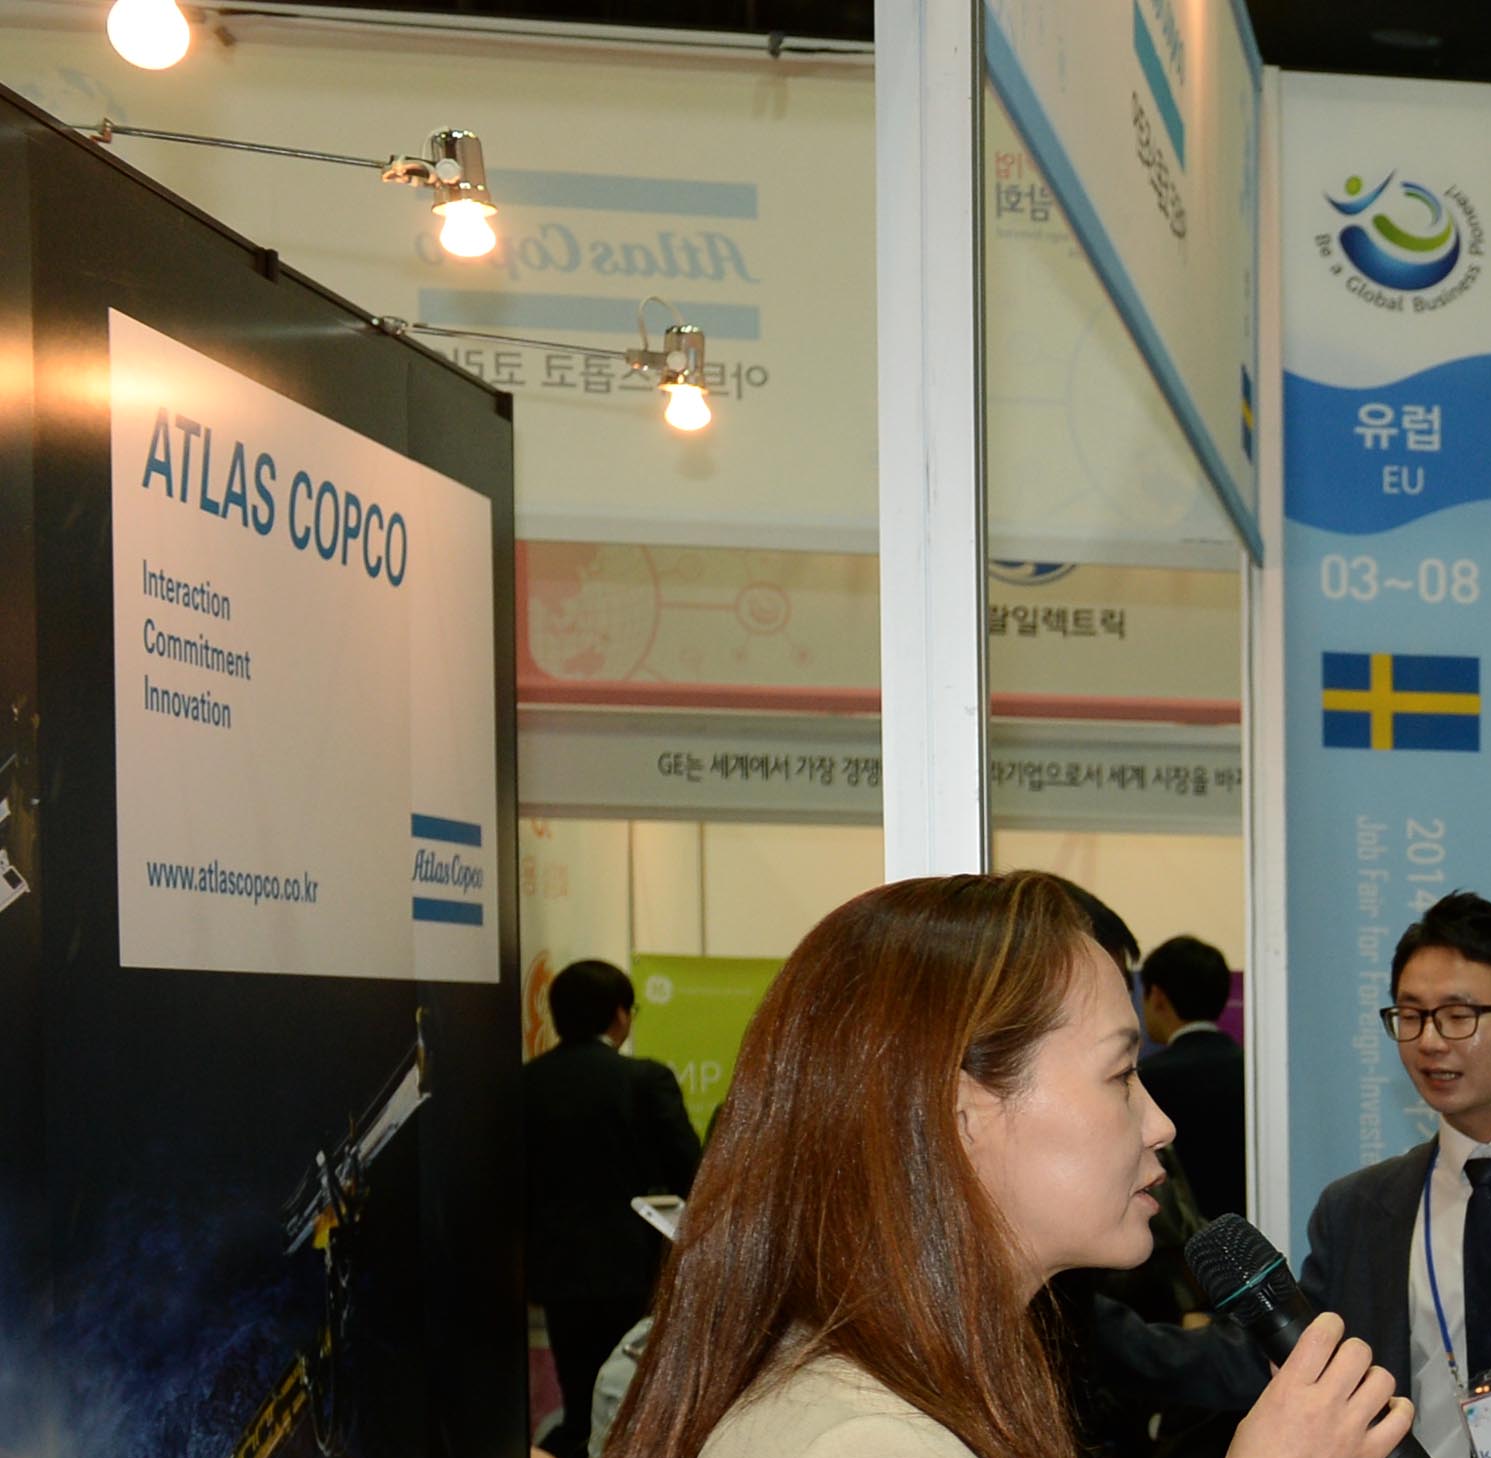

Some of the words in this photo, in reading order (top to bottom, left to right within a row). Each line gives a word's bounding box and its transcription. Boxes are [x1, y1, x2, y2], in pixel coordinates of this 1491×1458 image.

[1345, 275, 1404, 312] Global
[1412, 263, 1481, 313] Business
[1355, 402, 1441, 453] 유럽
[142, 406, 275, 536] ATLAS
[288, 470, 407, 586] COPCO
[1382, 465, 1425, 496] EU
[142, 559, 231, 621] Interaction
[1320, 553, 1480, 604] 03~08
[142, 618, 251, 681] Commitment
[143, 674, 232, 729] Innovation
[657, 752, 704, 783] GE는
[710, 752, 789, 782] 세계에서
[795, 754, 834, 786] 가장
[1107, 762, 1146, 790] 세계
[1152, 764, 1209, 797] 시장을
[1357, 814, 1389, 861] Job
[147, 859, 318, 906] www.atlascopco.co.kr
[411, 848, 449, 886] Atlas
[450, 852, 483, 891] Copco
[1357, 868, 1391, 918] Fair
[1357, 926, 1390, 964] for
